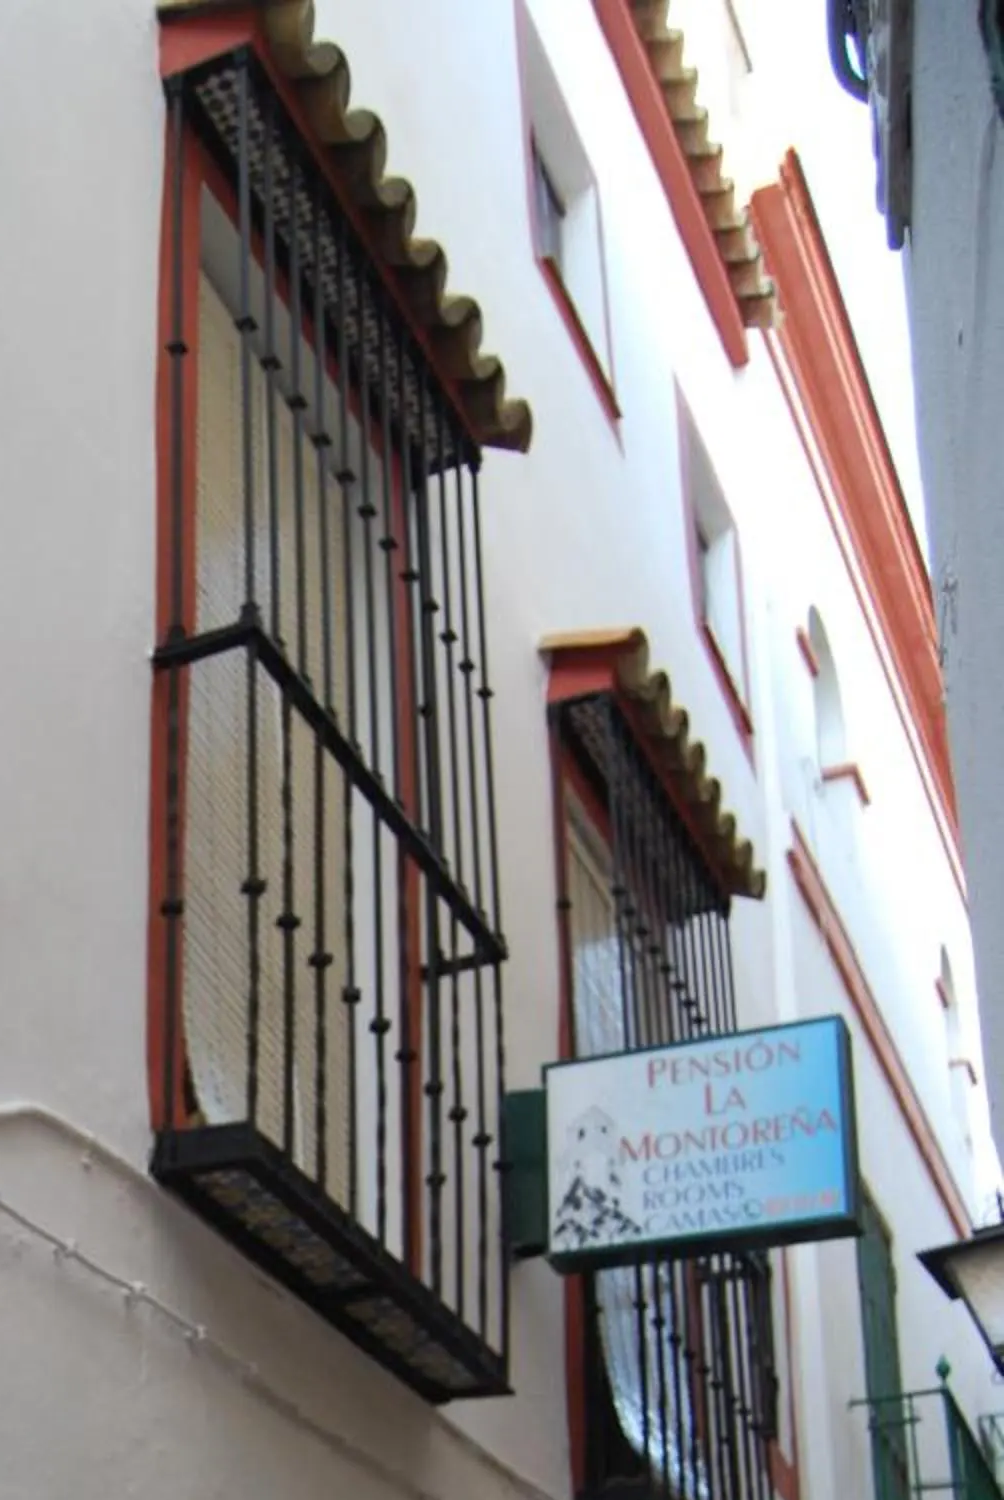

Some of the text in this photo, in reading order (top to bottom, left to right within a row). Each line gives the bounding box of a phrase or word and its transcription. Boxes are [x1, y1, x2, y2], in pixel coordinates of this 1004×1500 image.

[646, 1036, 801, 1088] PENSIÓN
[618, 1107, 837, 1163] MONTOREÑA
[642, 1150, 785, 1185] CHAMBRES
[641, 1183, 745, 1211] ROOMS
[643, 1206, 739, 1235] CAMAS
